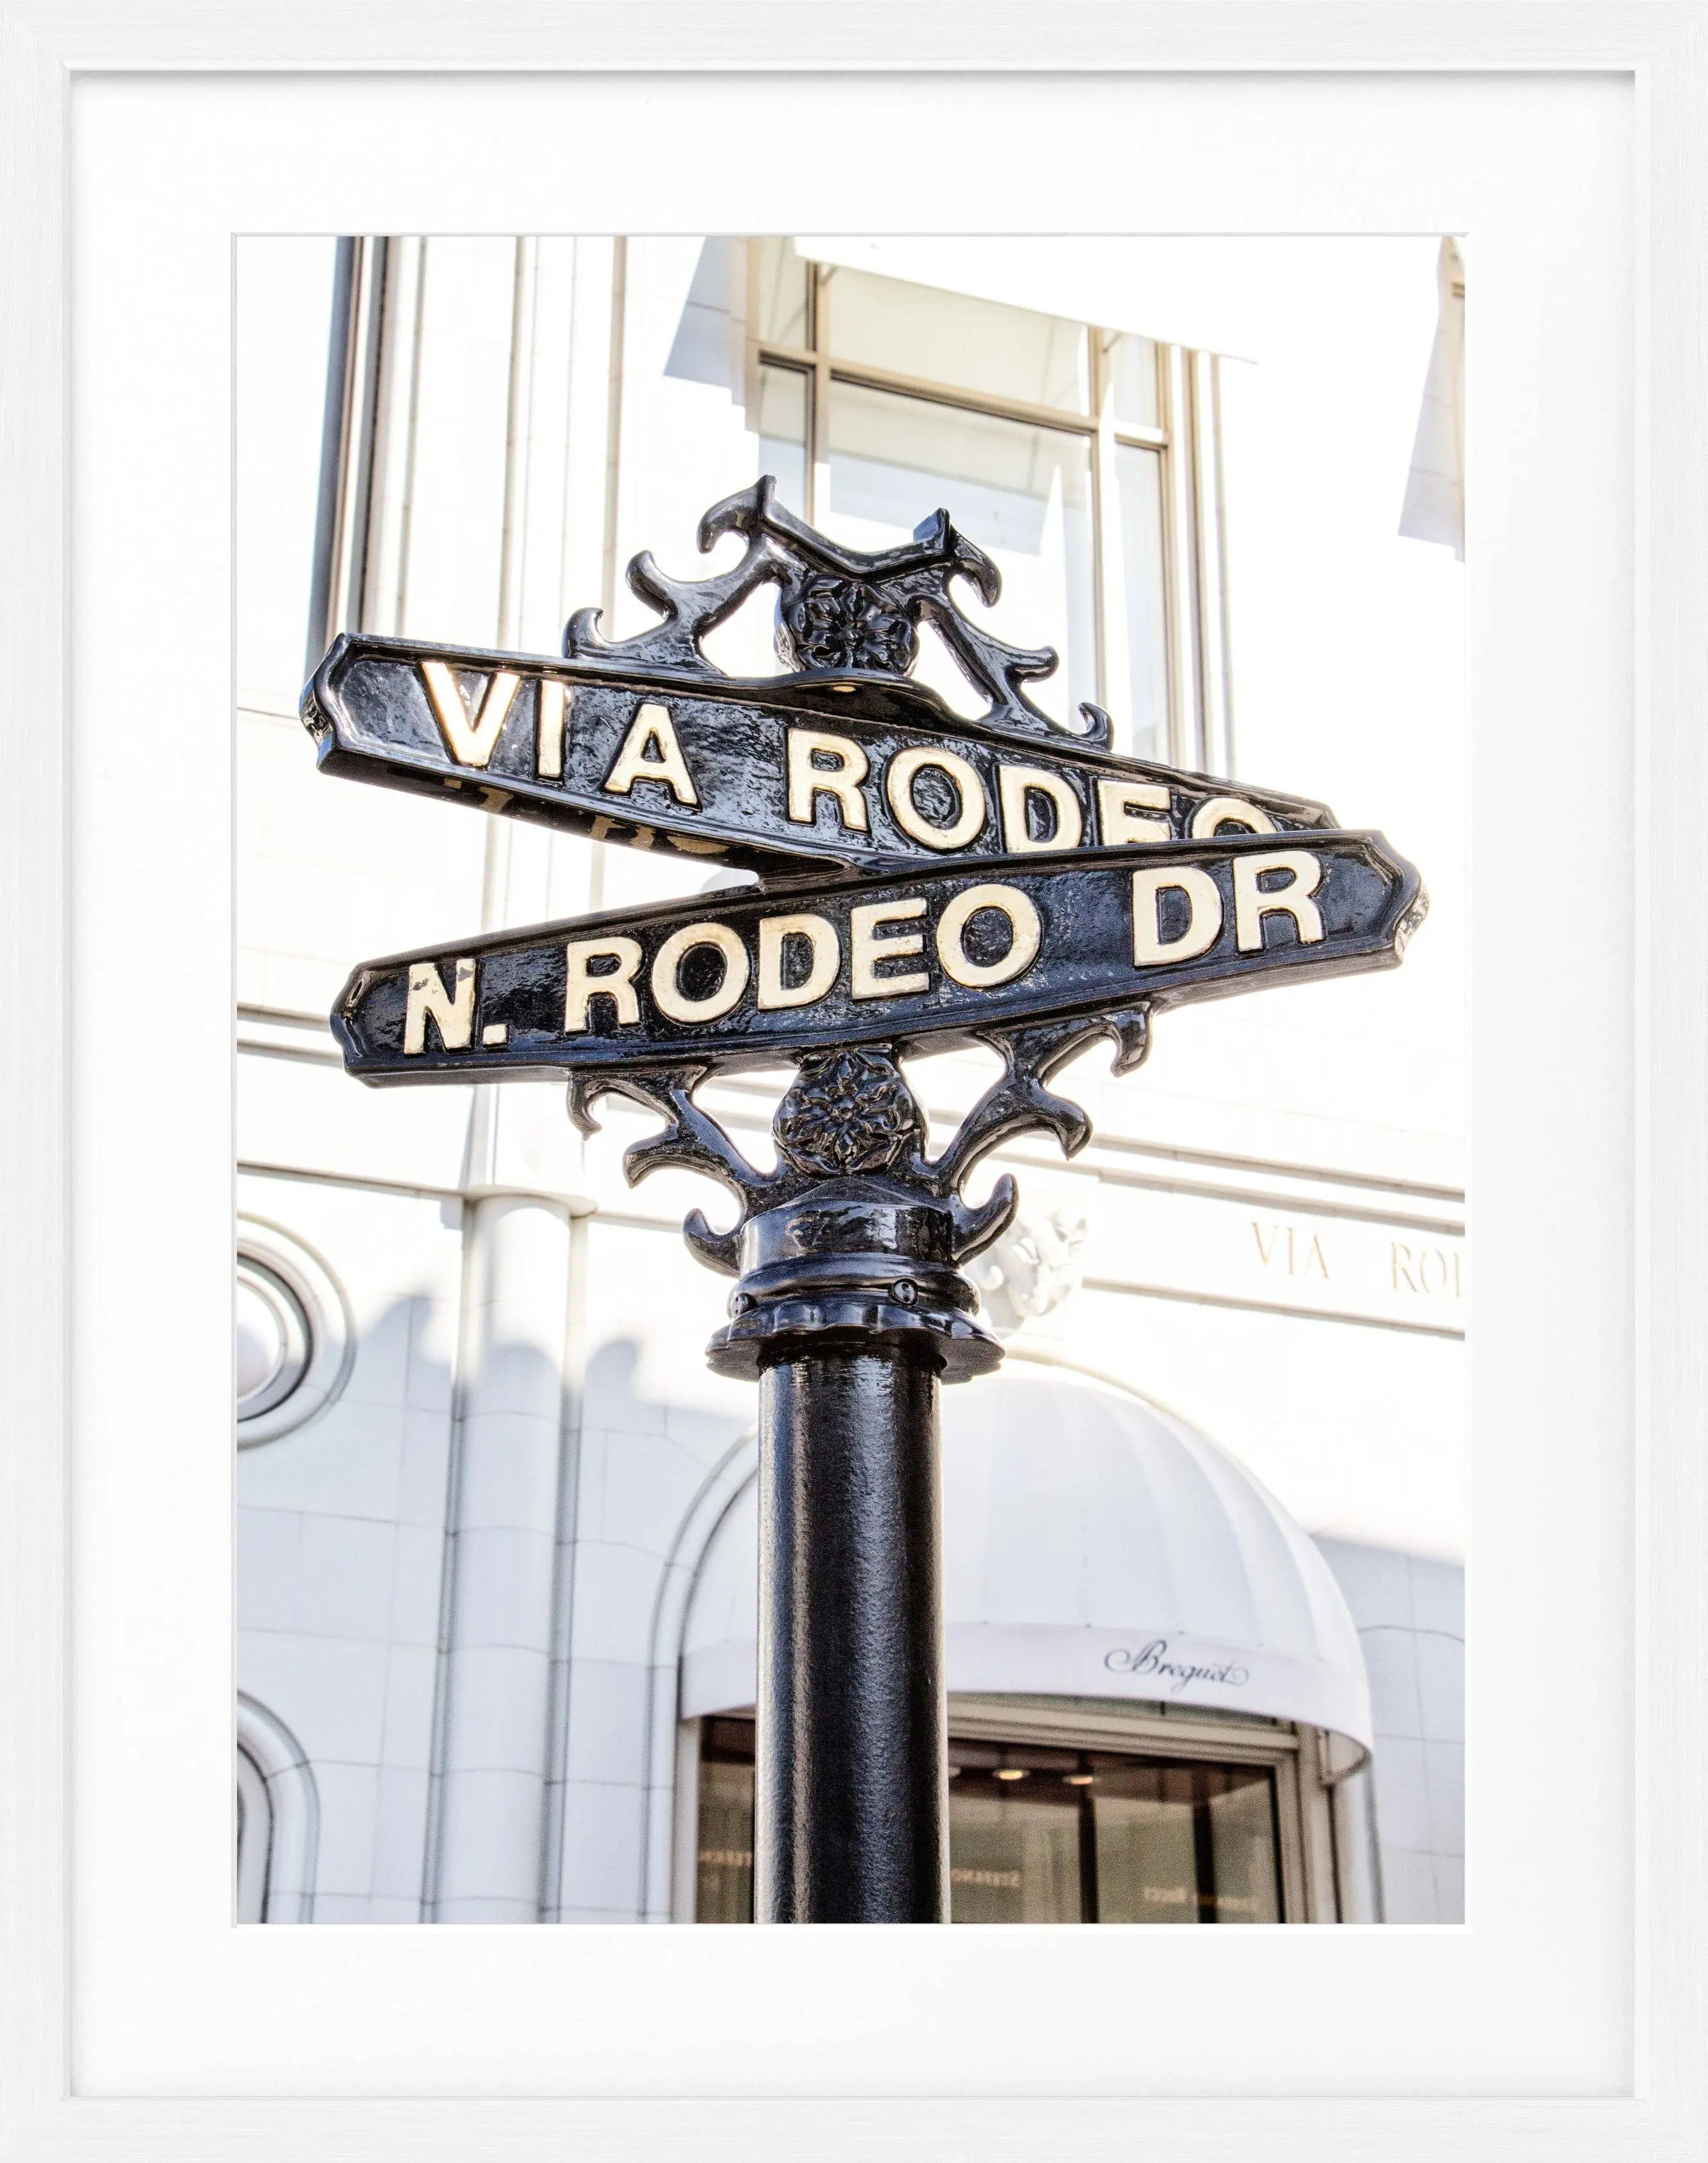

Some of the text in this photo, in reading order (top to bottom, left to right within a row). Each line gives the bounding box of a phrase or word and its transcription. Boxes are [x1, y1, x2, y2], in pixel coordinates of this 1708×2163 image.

[419, 661, 699, 811] VIA
[404, 850, 1324, 1056] N. RODEO DR
[1251, 1222, 1329, 1279] VIA
[1104, 1639, 1250, 1694] Breguet
